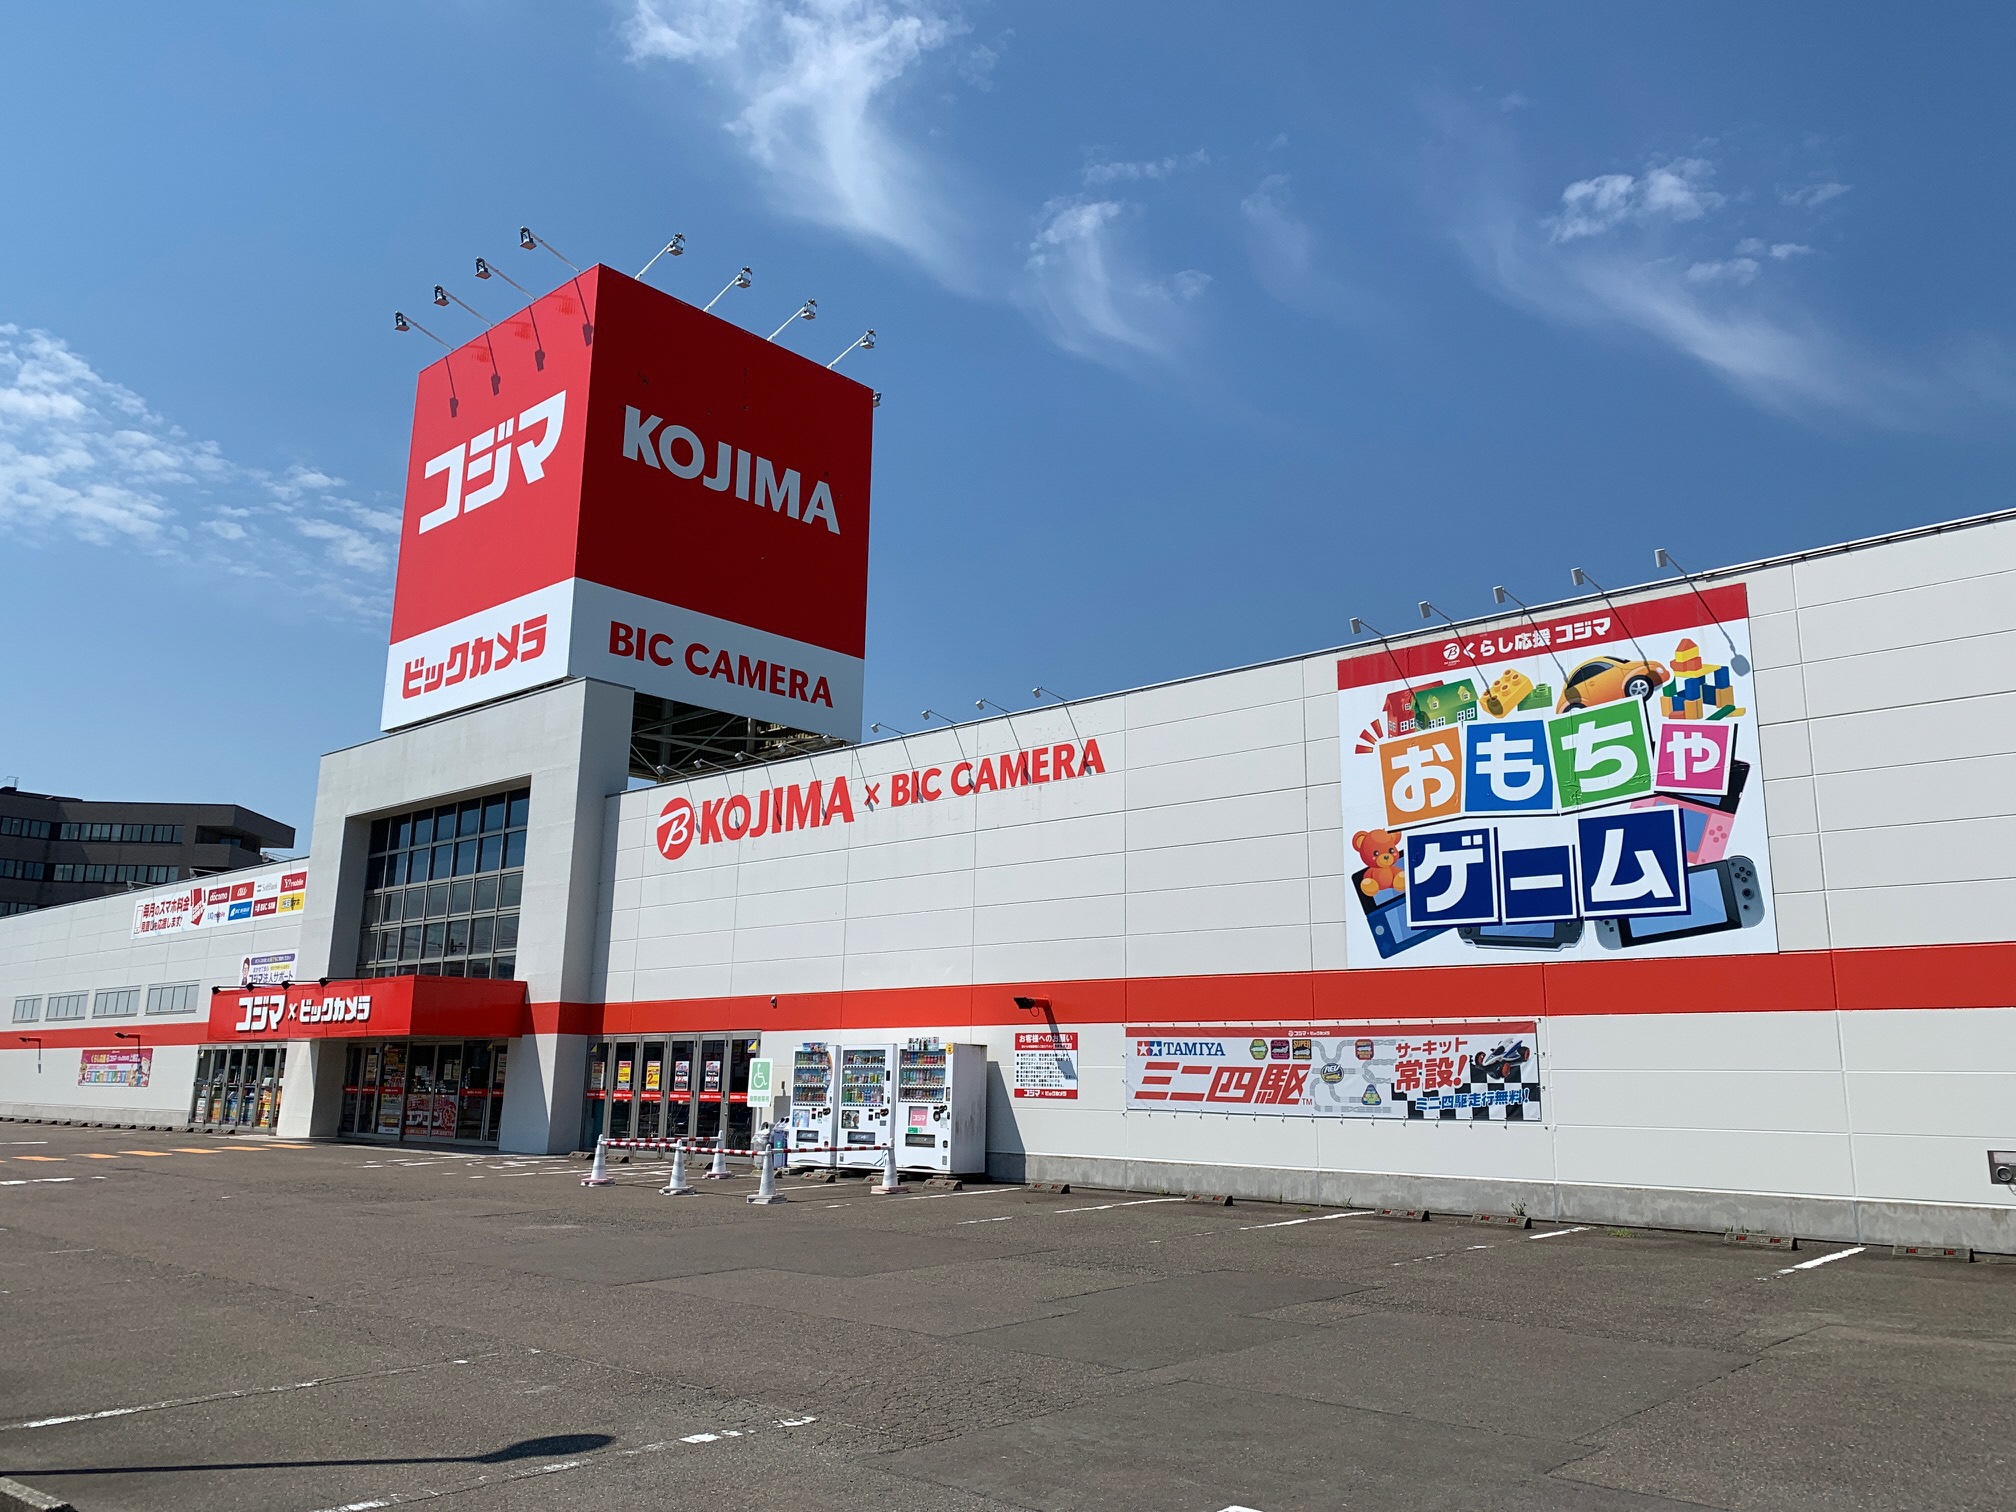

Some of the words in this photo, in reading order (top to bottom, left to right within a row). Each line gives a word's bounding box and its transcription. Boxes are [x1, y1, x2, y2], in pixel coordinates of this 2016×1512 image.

[418, 389, 567, 535] コジマ
[622, 403, 841, 535] KOJIMA
[402, 613, 548, 699] ビックカメラ
[1463, 628, 1551, 659] くらし応援
[1555, 617, 1611, 643] コジマ
[608, 619, 674, 667] BIC
[684, 642, 834, 708] CAMERA
[700, 775, 854, 846] KOJIMA
[890, 767, 942, 808] BIC
[950, 738, 1106, 795] CAMERA
[1413, 827, 1675, 913] ゲーム
[209, 891, 228, 902] docomo
[235, 994, 286, 1031] コジマ
[299, 995, 371, 1023] ビックカメラ
[1019, 1034, 1073, 1043] お客様へのお願い
[1163, 1042, 1226, 1056] TAMIYA
[1396, 1037, 1468, 1058] サーキット
[1024, 1089, 1040, 1097] コジマ
[1134, 1062, 1311, 1105] ミニ四駆
[1395, 1055, 1468, 1092] 常設!
[1415, 1088, 1530, 1110] ミニ四駆走行無料!
